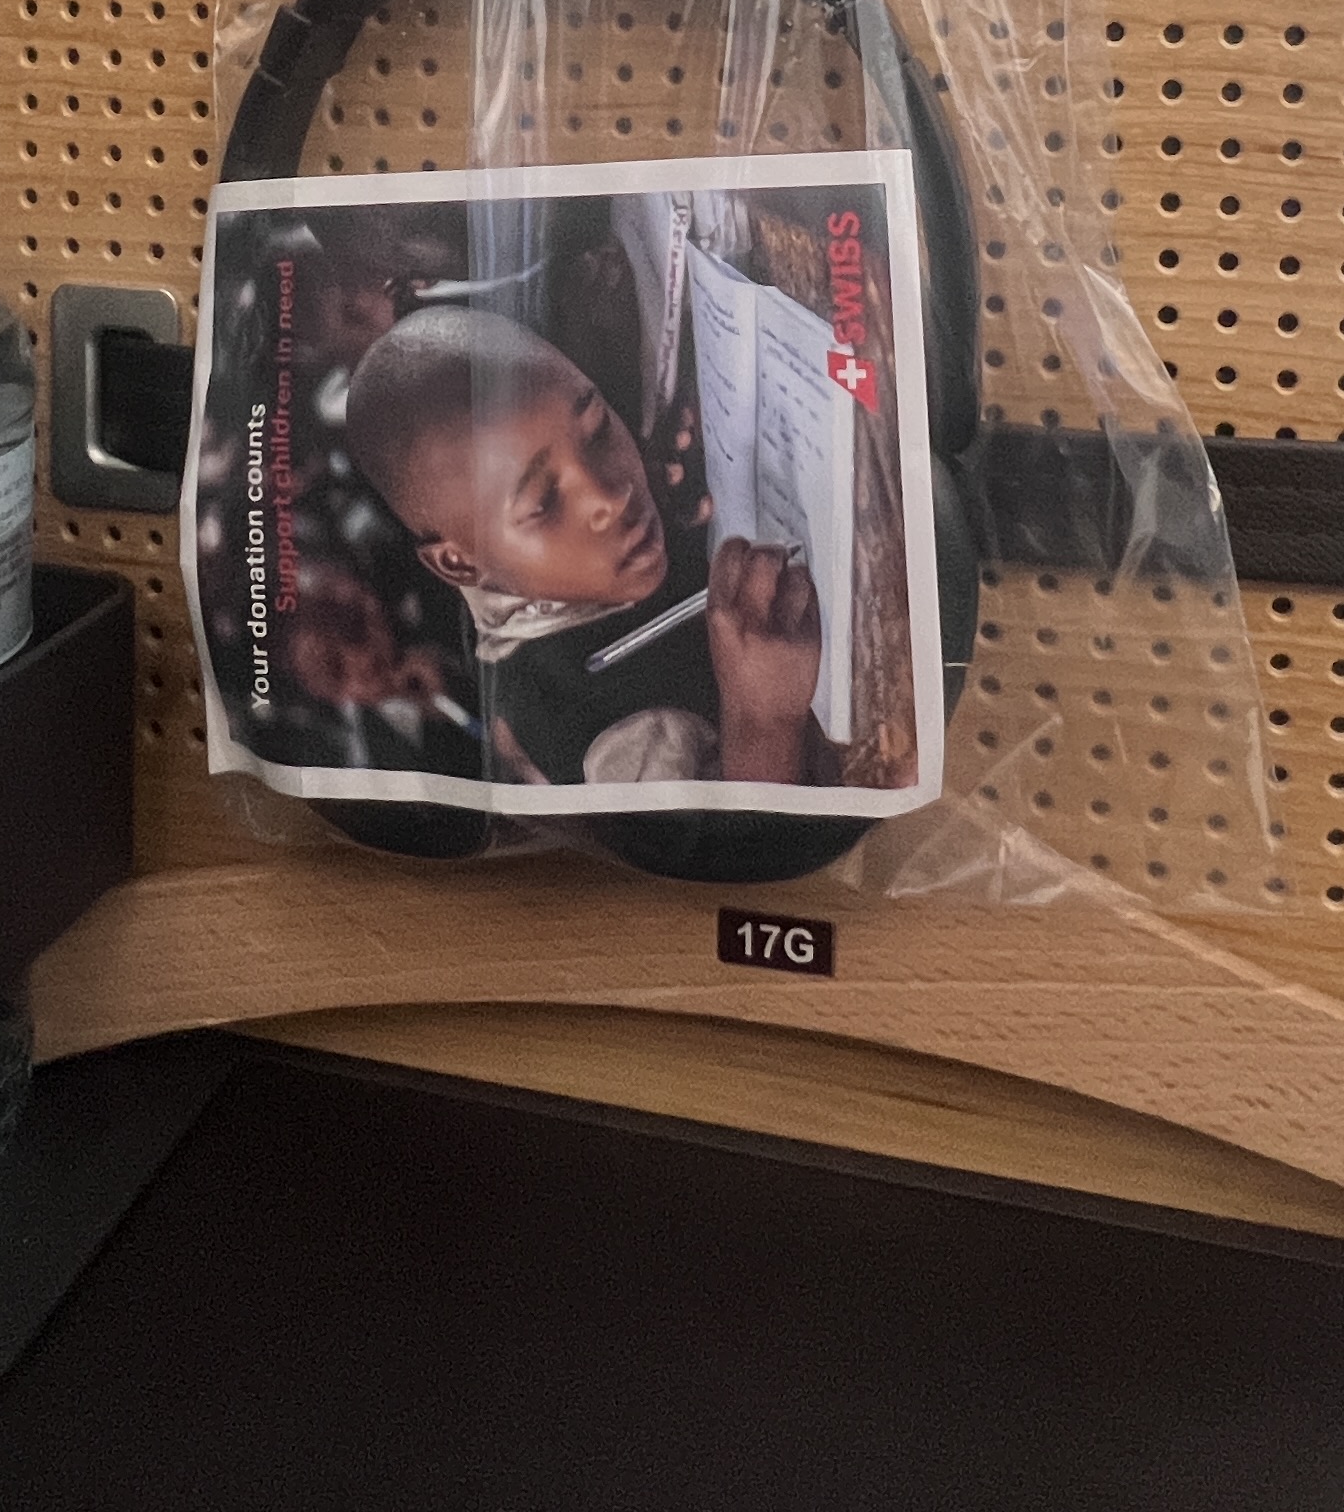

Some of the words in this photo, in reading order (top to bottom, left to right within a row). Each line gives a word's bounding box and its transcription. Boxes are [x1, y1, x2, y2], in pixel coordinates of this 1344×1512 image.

[276, 260, 295, 330] need
[826, 210, 866, 345] SWISS
[275, 337, 293, 363] in
[247, 402, 267, 502] counts
[270, 369, 293, 488] children
[245, 509, 268, 638] donation
[273, 494, 299, 613] Support
[251, 644, 271, 710] Your
[737, 921, 814, 964] 17G
